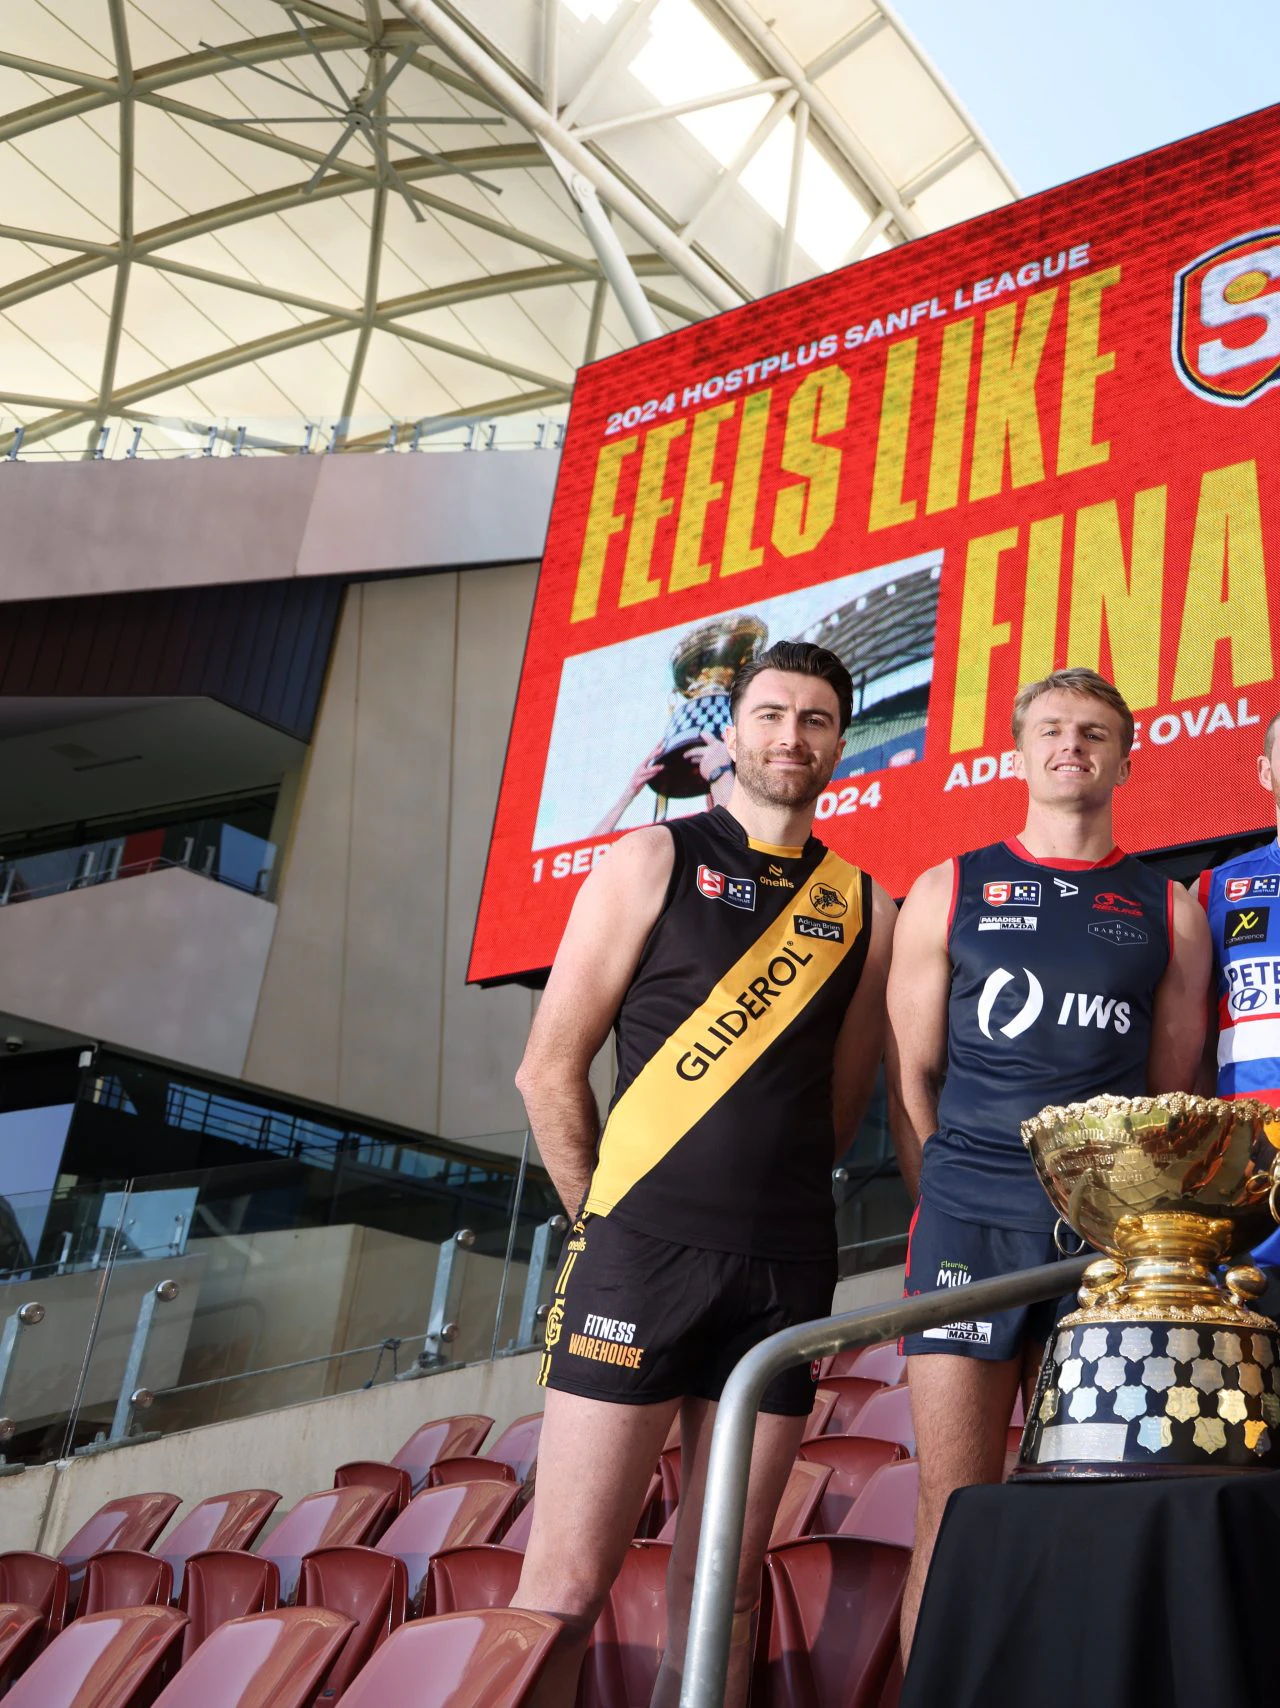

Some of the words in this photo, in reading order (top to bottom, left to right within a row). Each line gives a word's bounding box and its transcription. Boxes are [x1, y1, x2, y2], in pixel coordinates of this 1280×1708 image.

[604, 393, 676, 436] 2024
[681, 338, 838, 409] HOSTPLUS
[844, 297, 946, 350] SANFL
[953, 243, 1091, 311] LEAGUE
[571, 364, 851, 624] FEELS
[867, 265, 1121, 533] LIKE
[1149, 698, 1260, 746] OVAL
[532, 858, 545, 883] 1
[815, 782, 881, 820] 024
[799, 918, 821, 928] Adrian
[823, 922, 840, 931] Brien
[1057, 992, 1131, 1035] IWS
[583, 1313, 636, 1344] FITNESS
[949, 1330, 987, 1342] MAZDA
[568, 1333, 644, 1369] WAREHOUSE
